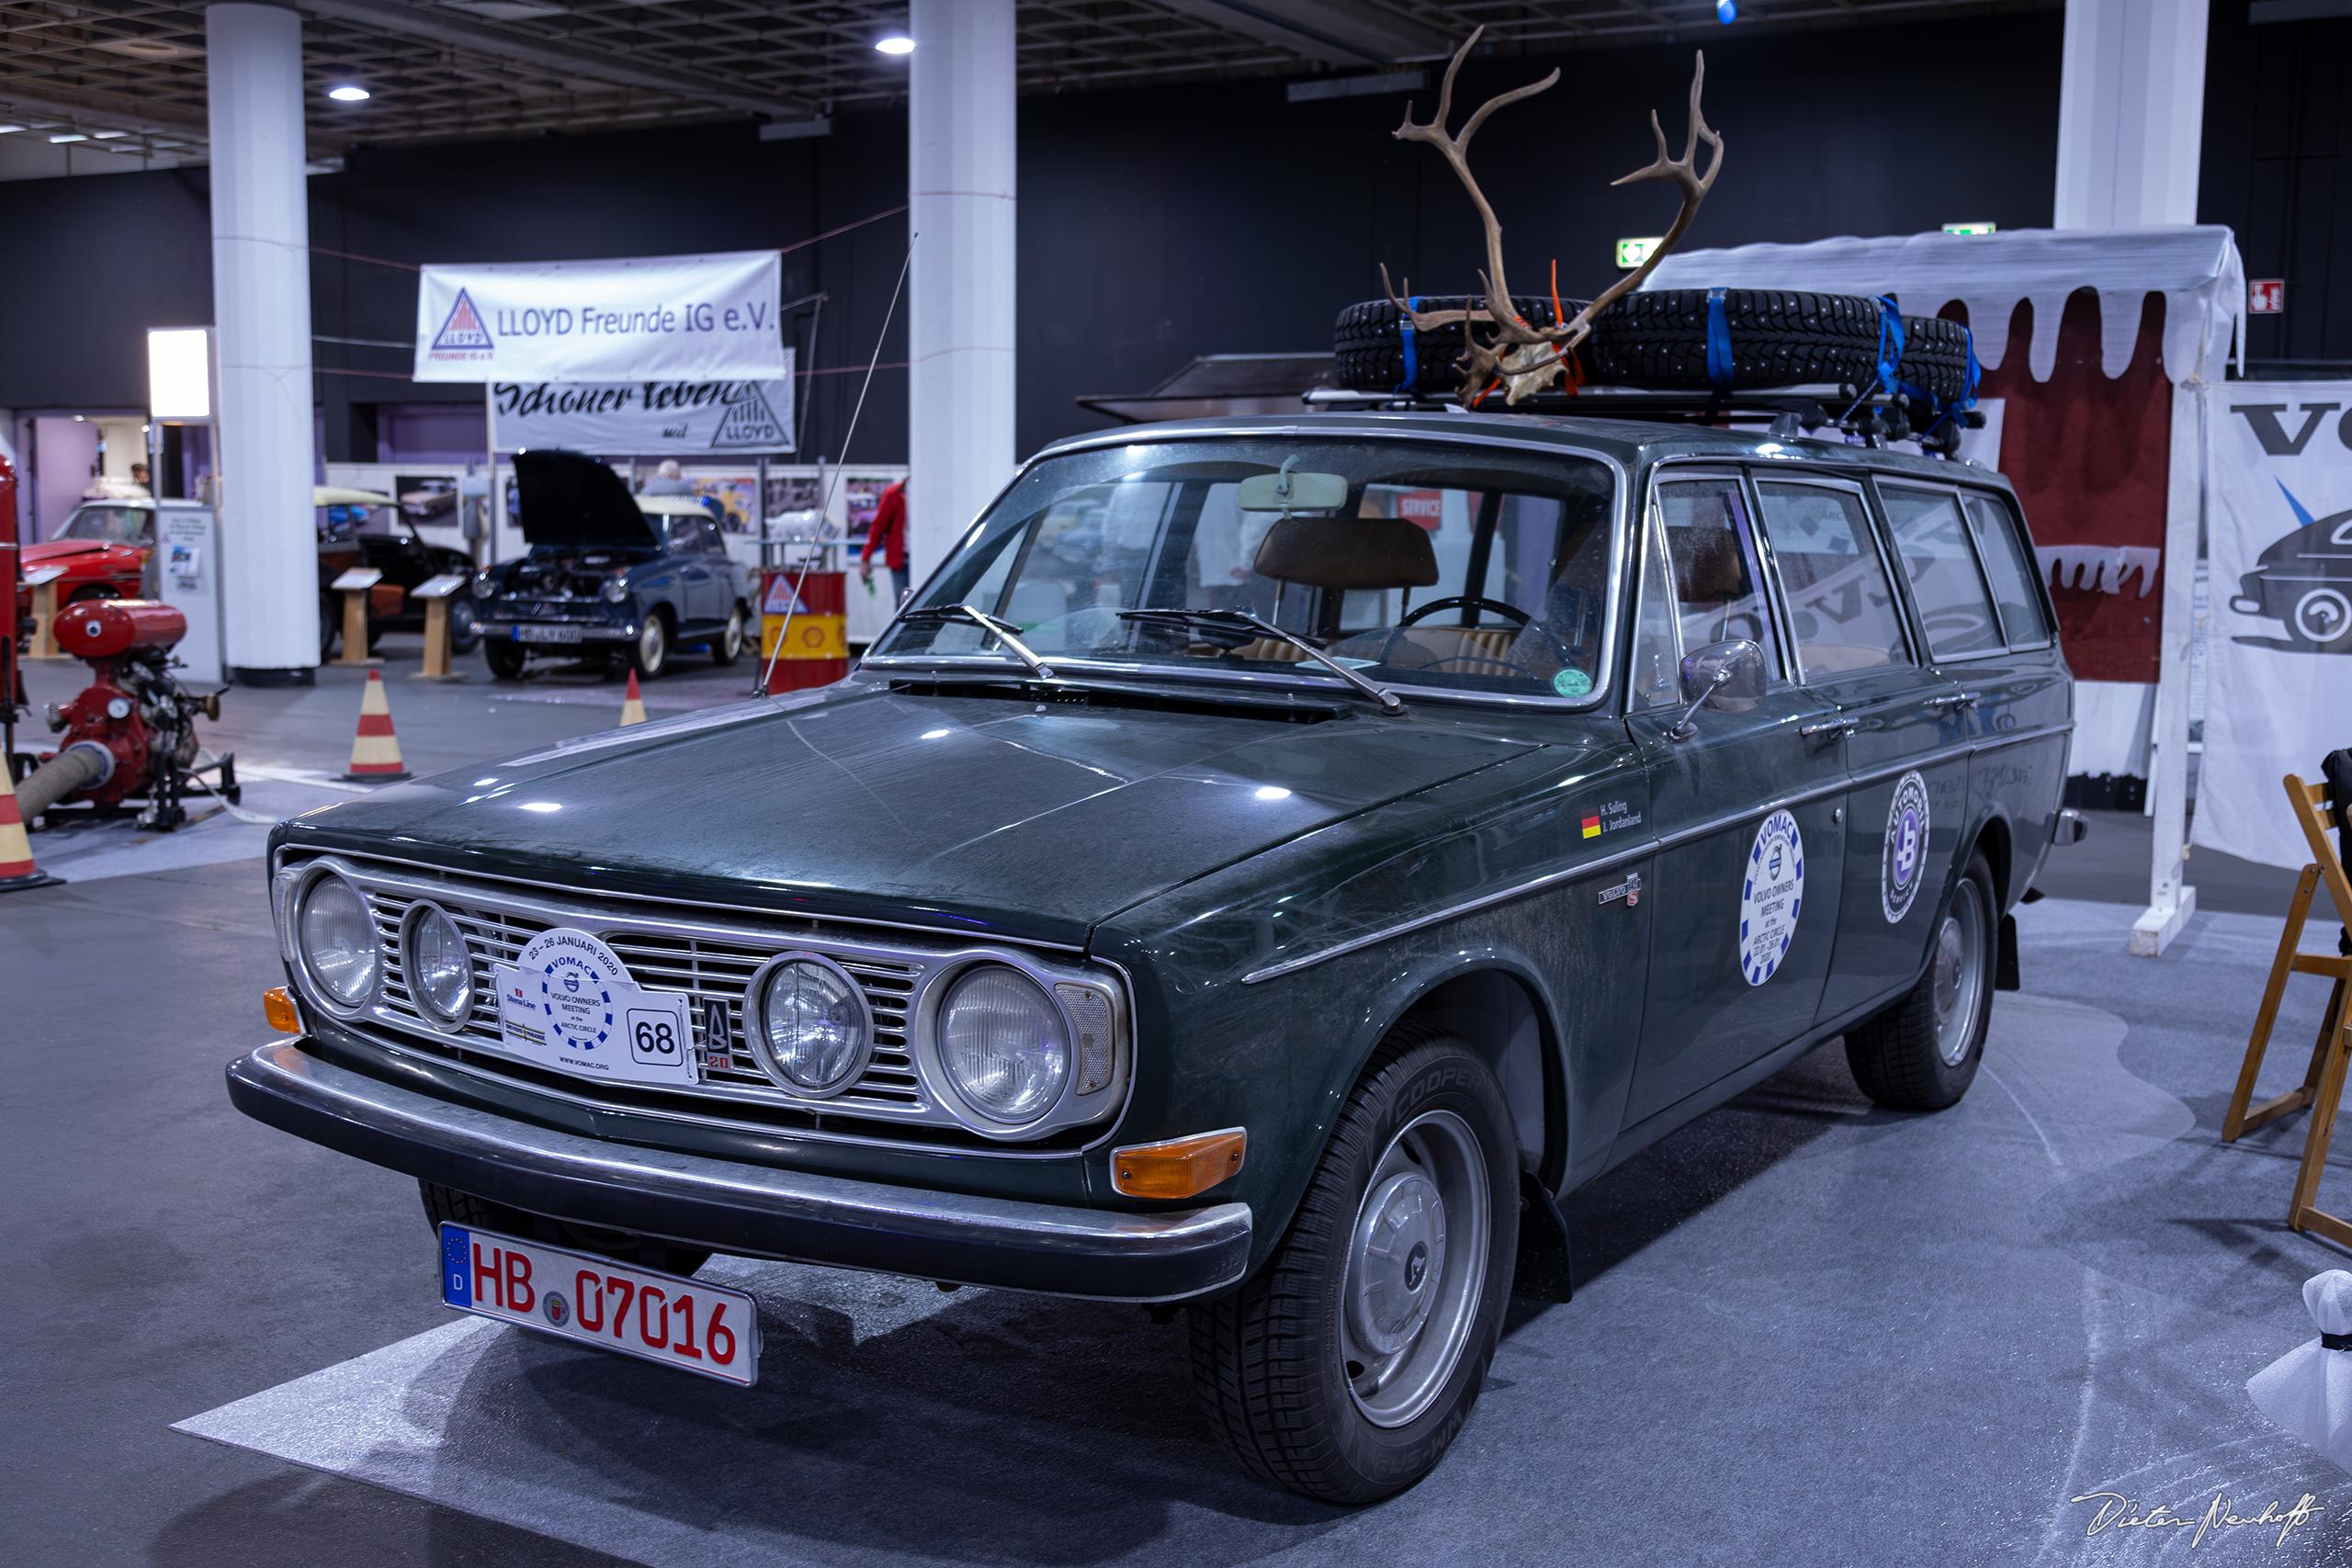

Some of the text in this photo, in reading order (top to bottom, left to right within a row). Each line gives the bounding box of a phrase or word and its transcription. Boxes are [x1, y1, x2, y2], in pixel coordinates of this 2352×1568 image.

[498, 301, 775, 336] LLOYD Freunde IG e.V.
[726, 424, 775, 440] LLOYD
[1402, 500, 1441, 516] SERVICE
[1760, 815, 1793, 846] VOMAC
[1602, 886, 1626, 900] VOLVO
[1753, 879, 1794, 905] VOLVO OWNERS
[1890, 880, 1914, 904] SERVICE
[1761, 898, 1784, 918] MEETING
[1753, 924, 1785, 947] ARCTIC CIRCLE
[528, 947, 539, 960] 23
[544, 937, 555, 949] 26
[557, 936, 597, 955] JANUARI
[597, 952, 618, 976] 2020
[1760, 952, 1772, 964] 2020
[551, 956, 592, 976] VOMAC
[506, 994, 536, 1010] Stena Line
[550, 992, 601, 1007] VOLVO OWNERS
[561, 1003, 591, 1015] MEETING
[561, 1021, 597, 1033] ARCTIC CIRCLE
[636, 1021, 675, 1055] 68
[559, 1055, 609, 1070] WWW.VOMAC.ORG
[709, 1055, 729, 1069] 20
[1396, 1066, 1483, 1123] COOPER
[453, 1274, 463, 1291] D
[472, 1242, 536, 1313] HB
[575, 1269, 737, 1366] 07016
